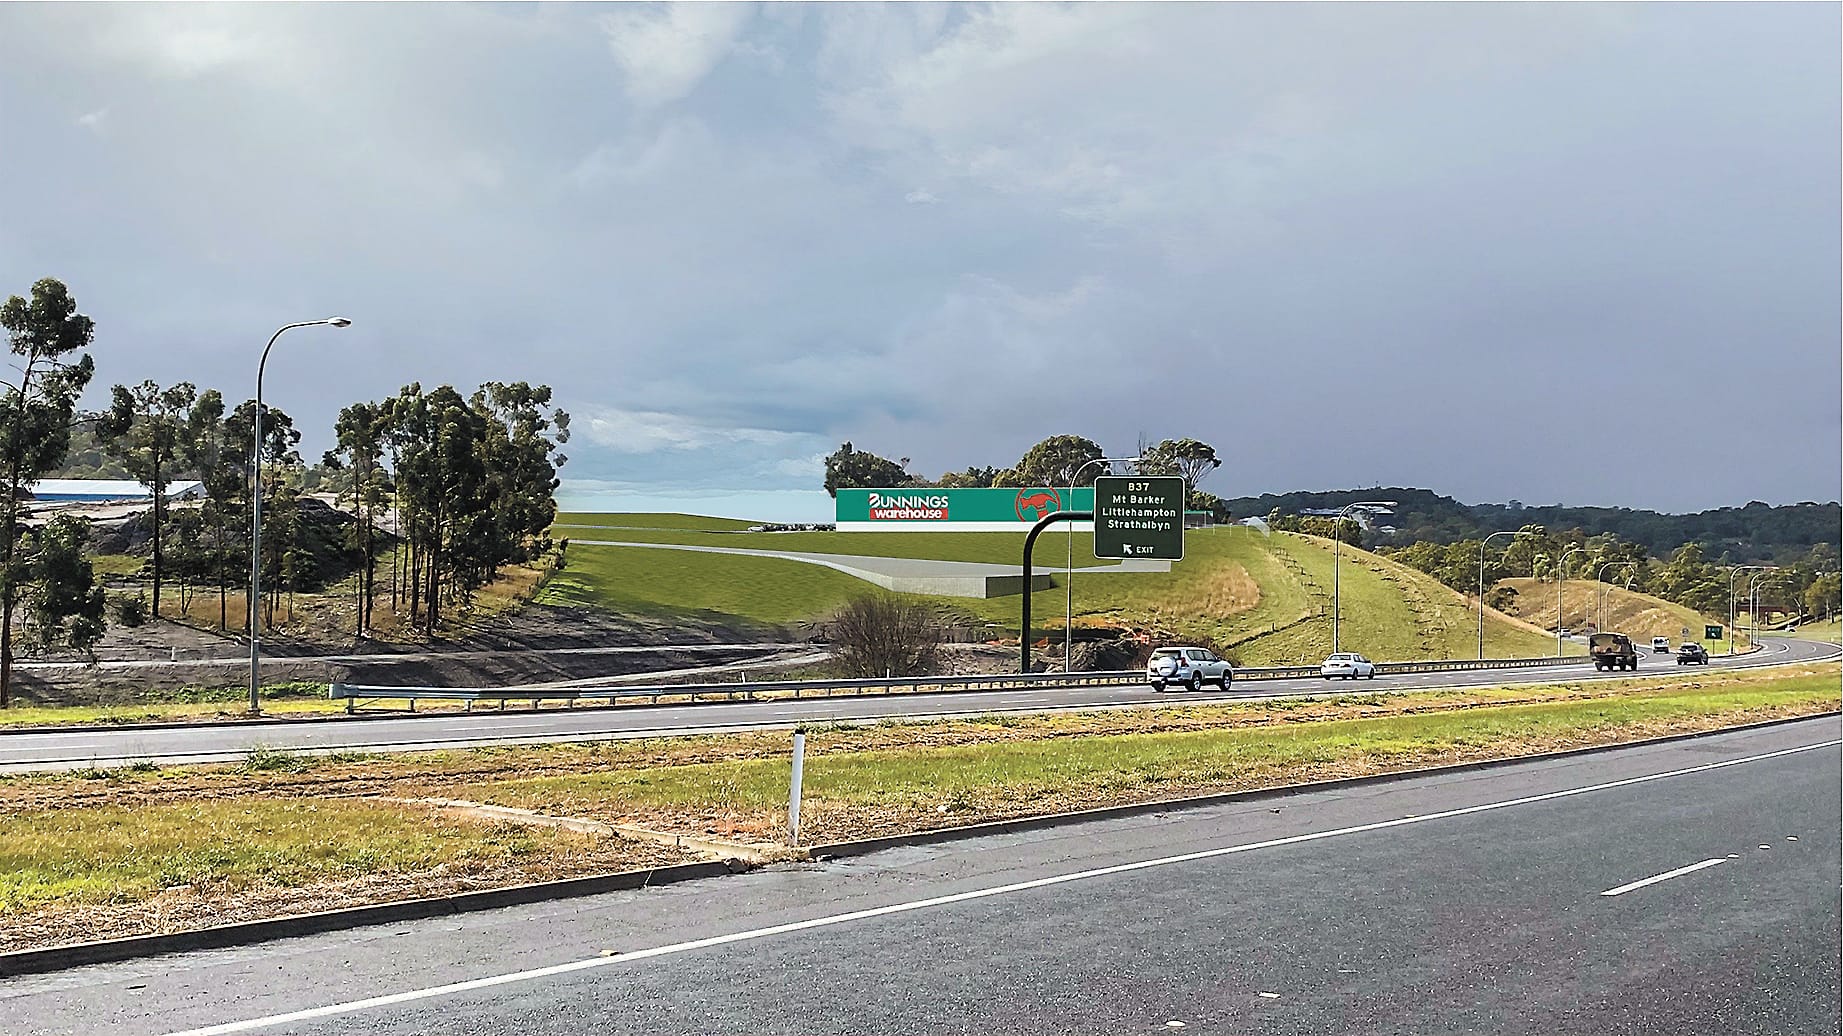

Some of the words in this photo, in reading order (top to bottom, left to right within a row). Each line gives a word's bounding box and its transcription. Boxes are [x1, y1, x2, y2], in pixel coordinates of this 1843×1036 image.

[1128, 482, 1150, 491] B37
[868, 493, 949, 508] BUNNINGS
[1112, 495, 1127, 504] Mt
[1130, 495, 1166, 504] Barker
[875, 507, 943, 519] warehouse
[1102, 507, 1176, 518] Littlehampton
[1107, 519, 1171, 531] Strathalbyn
[1136, 546, 1154, 554] EXIT
